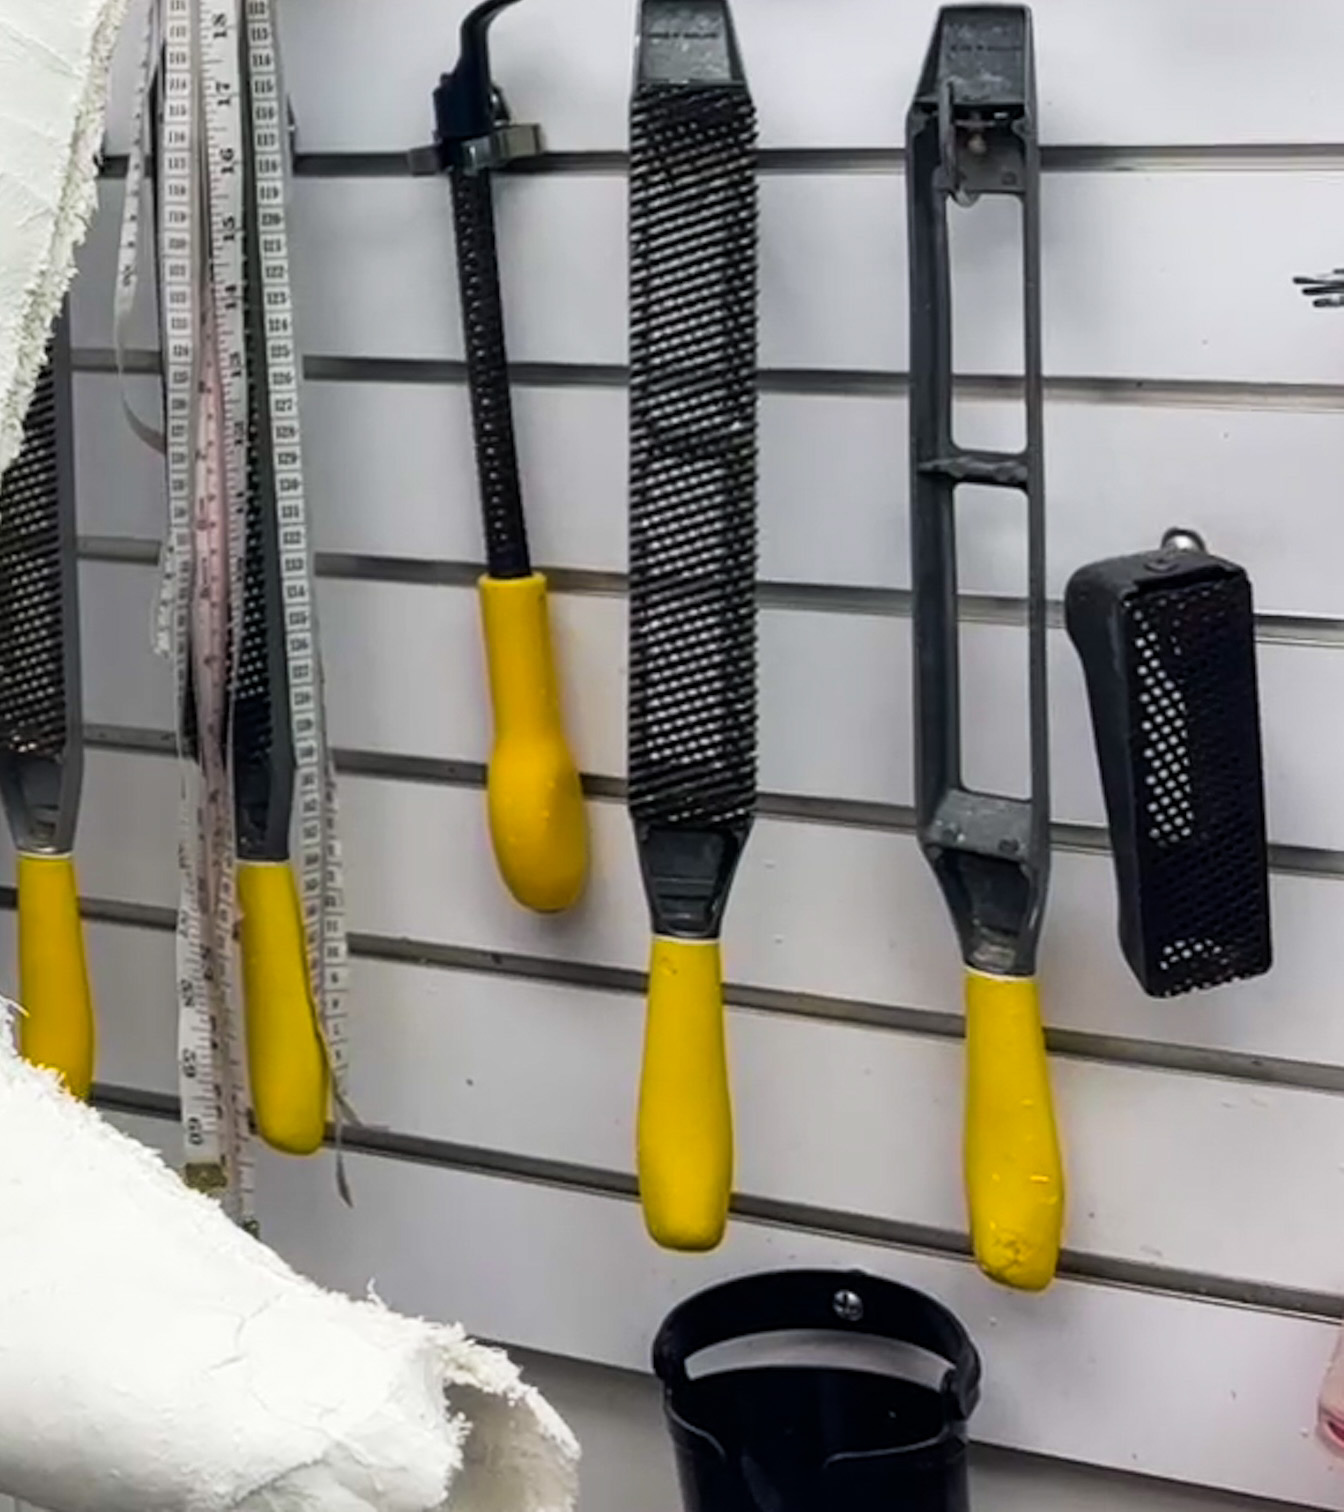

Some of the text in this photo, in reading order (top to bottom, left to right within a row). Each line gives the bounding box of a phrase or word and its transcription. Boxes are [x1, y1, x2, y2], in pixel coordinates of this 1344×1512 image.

[213, 12, 228, 40] 18
[216, 81, 231, 107] 17
[219, 147, 235, 175] 16
[222, 216, 236, 242] 15
[188, 1116, 204, 1146] 60
